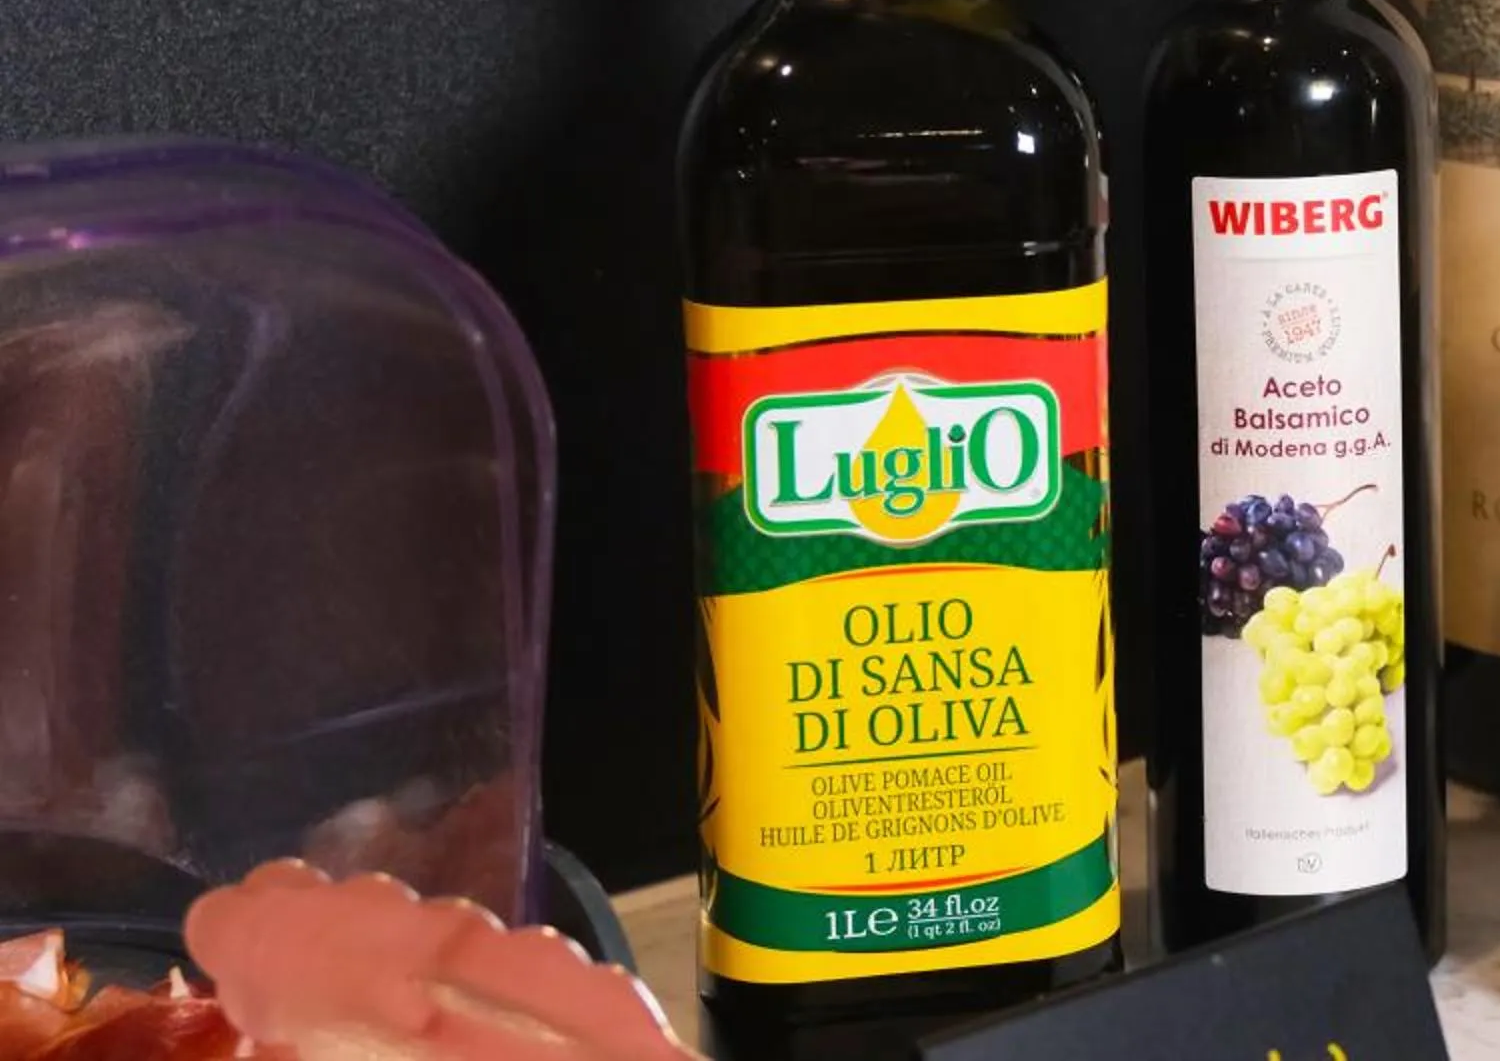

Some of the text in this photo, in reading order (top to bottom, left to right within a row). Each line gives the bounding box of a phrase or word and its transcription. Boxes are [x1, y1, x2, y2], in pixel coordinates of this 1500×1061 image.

[1263, 375, 1342, 399] Aceto
[1234, 405, 1370, 430] Balsamico
[1210, 432, 1391, 458] di Modena g.g.A.
[843, 598, 974, 647] OLIO
[786, 645, 1034, 704] DI SANSA
[794, 695, 1030, 754] DI OLIVA
[811, 762, 1013, 797] OLIVE POMACE OIL
[812, 782, 1013, 821] OLIVENTRESTERÖL
[759, 802, 1066, 848] HUILE DE GRIGNONS D'OLIVE
[864, 843, 966, 874] 1 ЛИТР
[907, 897, 939, 920] 34
[924, 924, 943, 940] qt
[945, 922, 955, 935] 2
